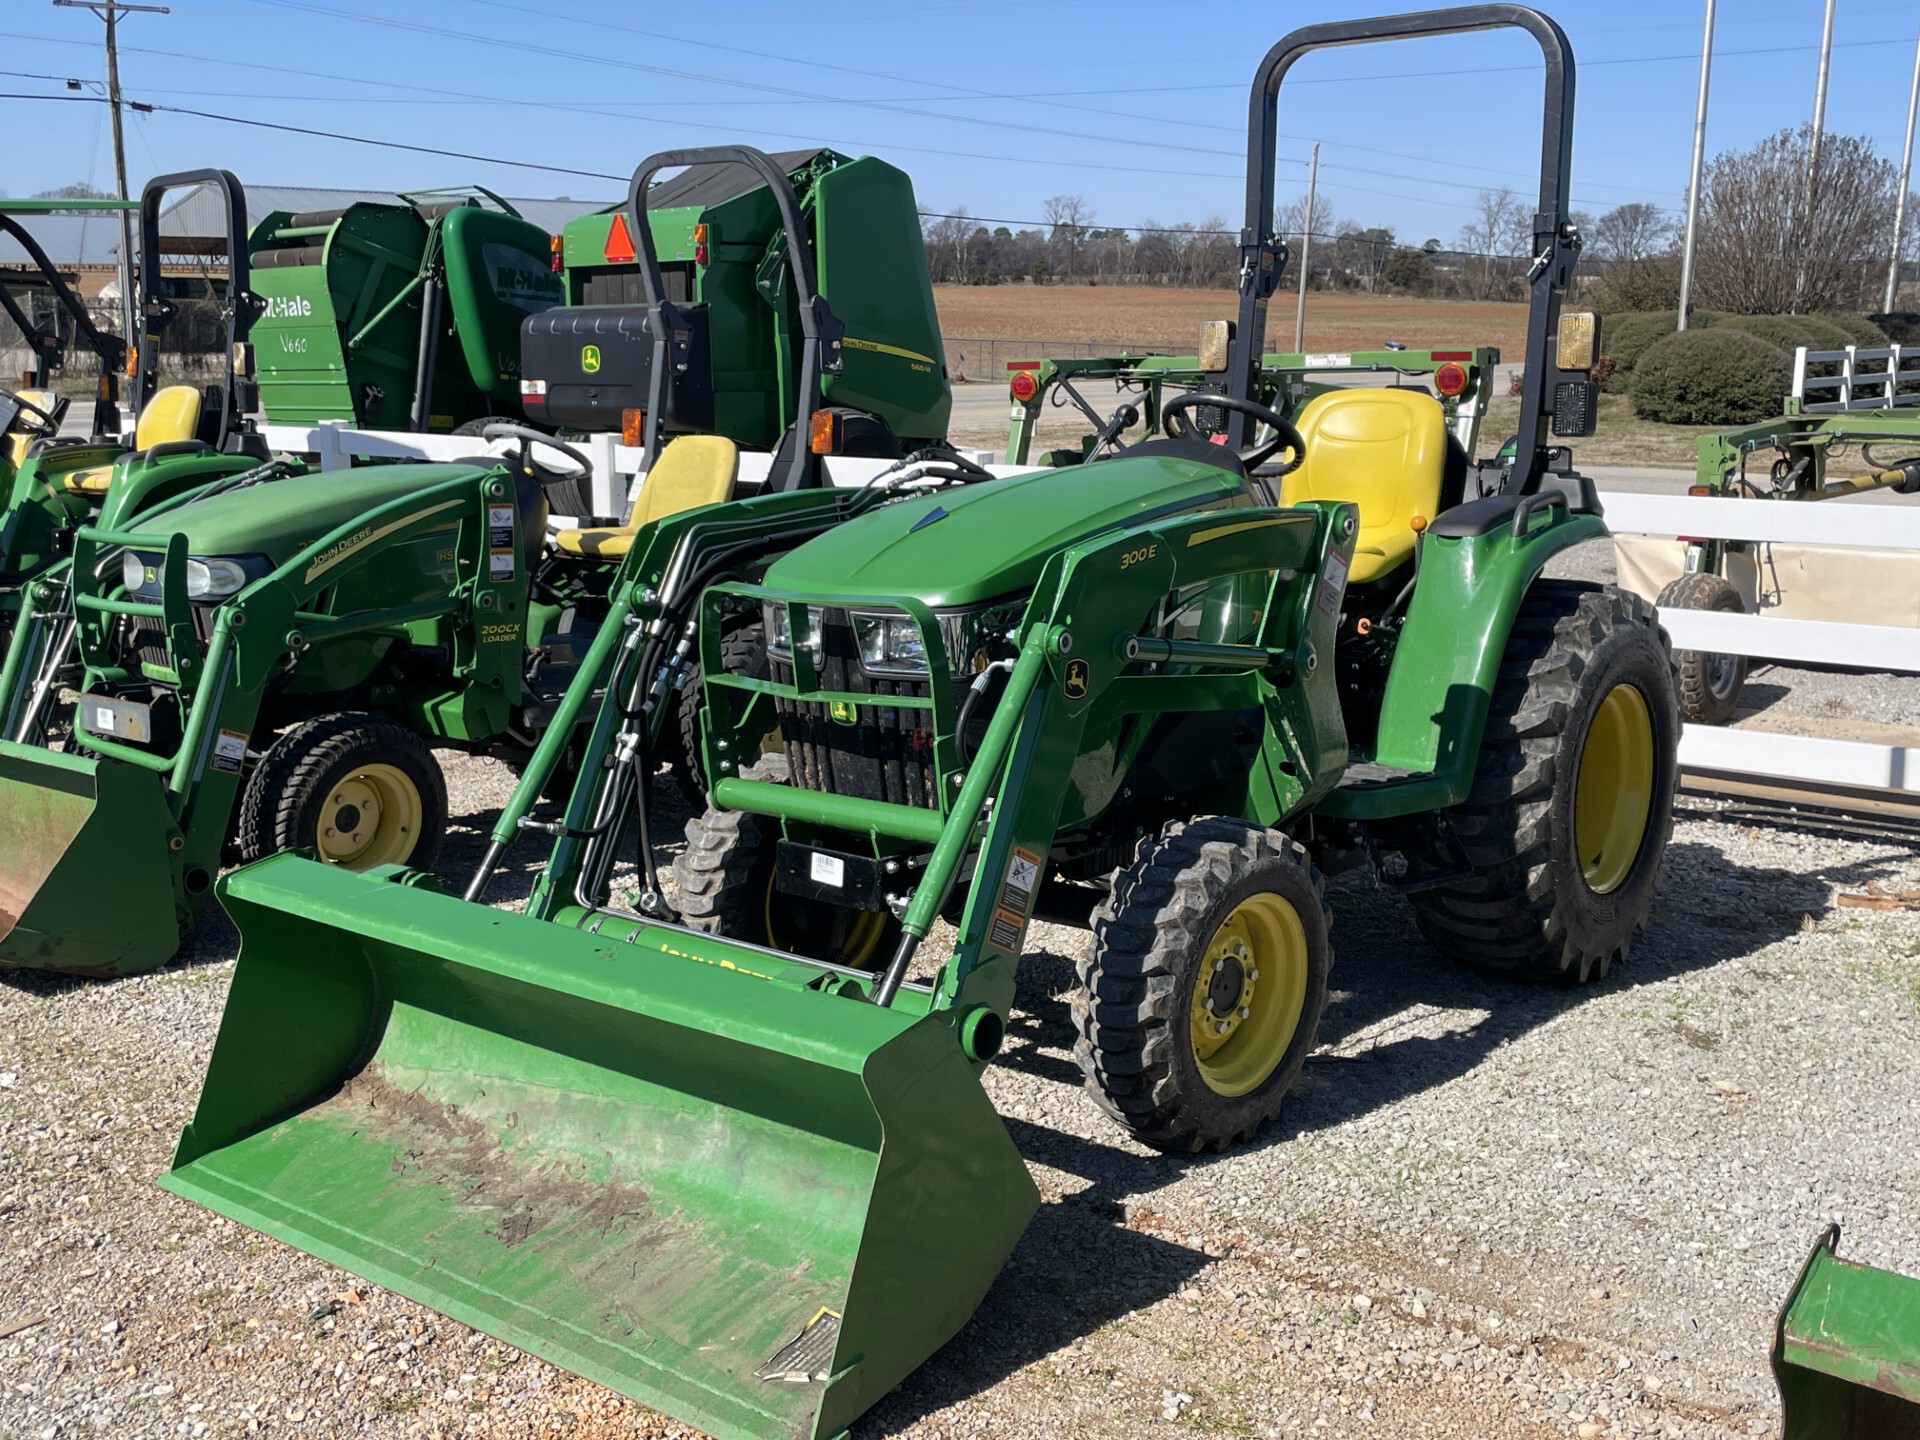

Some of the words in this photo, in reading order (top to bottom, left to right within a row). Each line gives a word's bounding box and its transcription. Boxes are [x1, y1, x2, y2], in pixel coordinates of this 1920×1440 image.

[279, 333, 308, 353] V660
[311, 546, 339, 568] JOHN
[338, 526, 373, 552] DEERE
[481, 623, 520, 635] 200CX
[483, 634, 517, 643] LOADER
